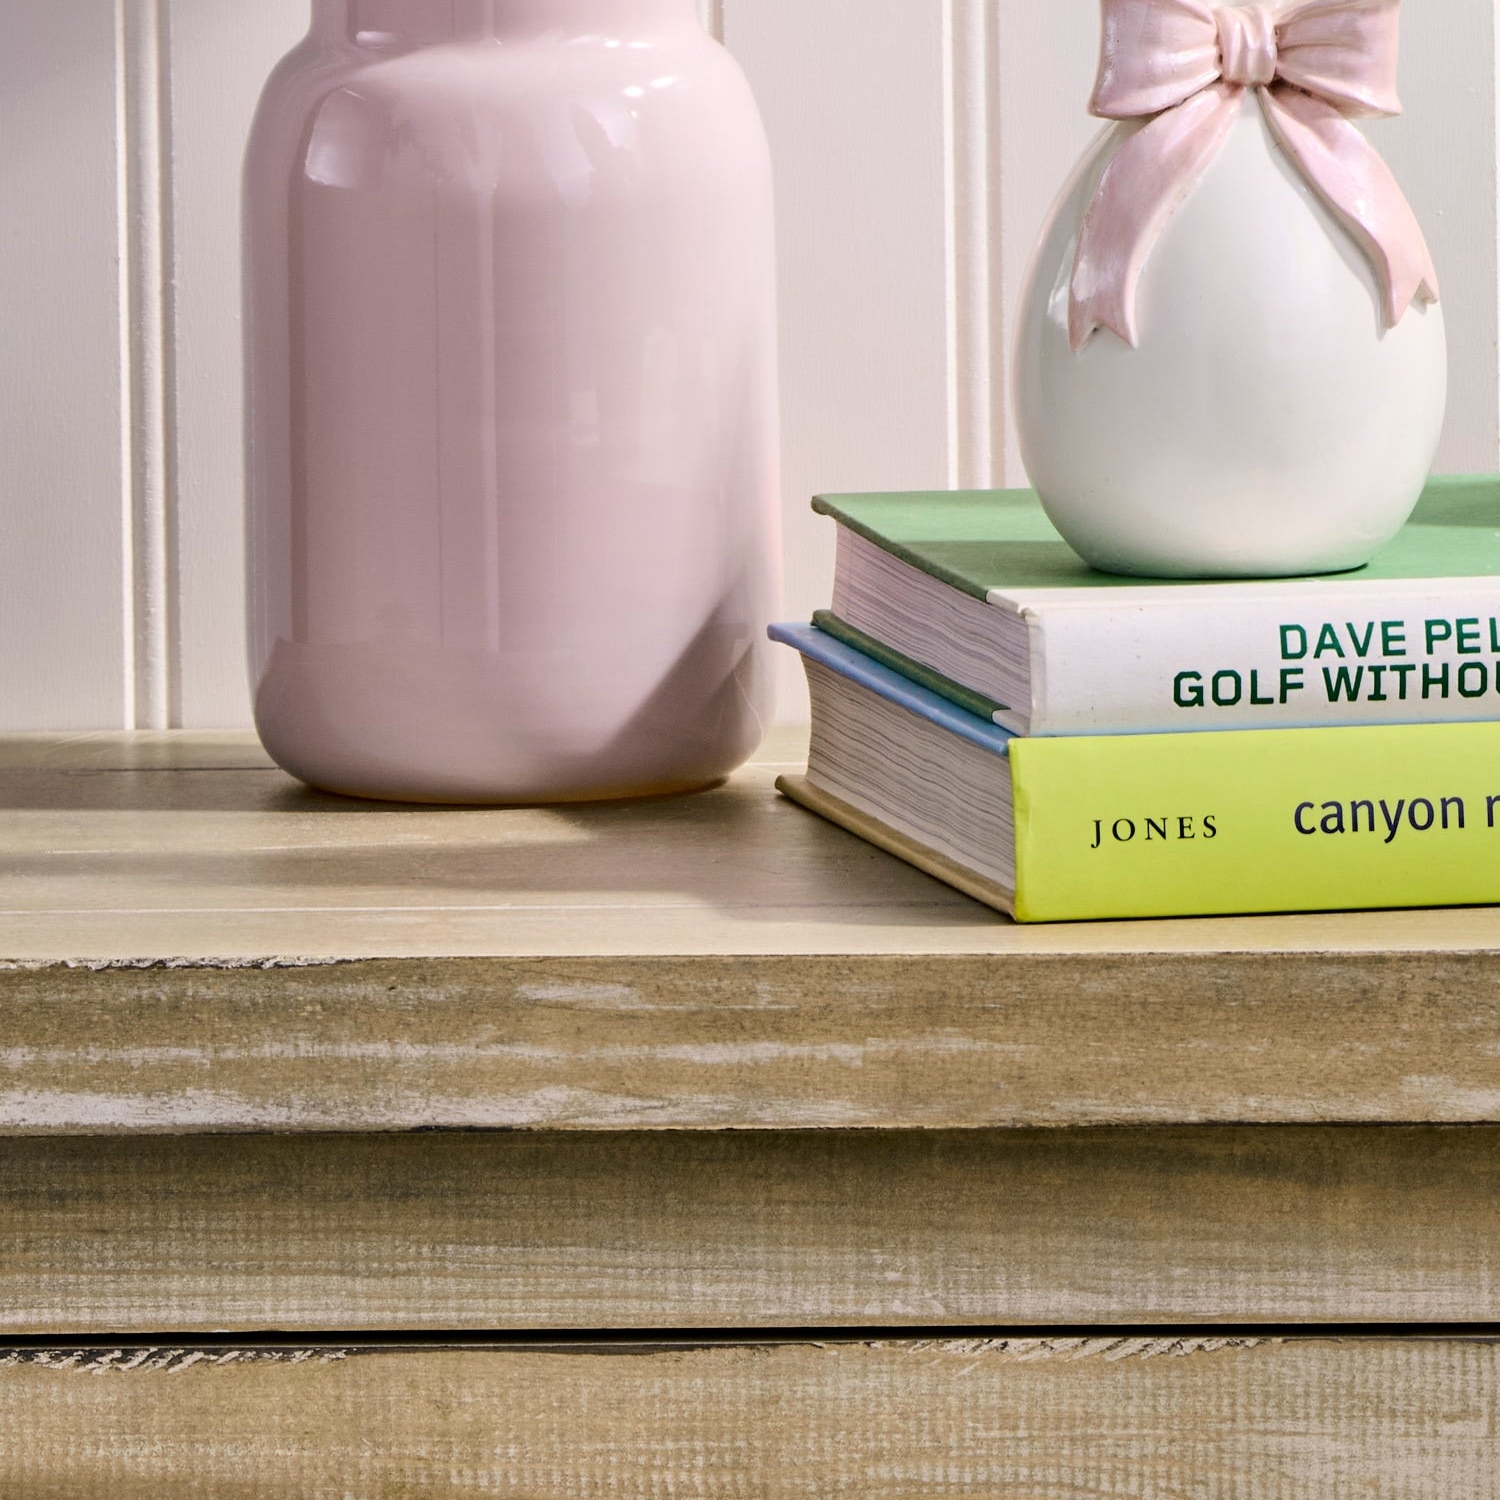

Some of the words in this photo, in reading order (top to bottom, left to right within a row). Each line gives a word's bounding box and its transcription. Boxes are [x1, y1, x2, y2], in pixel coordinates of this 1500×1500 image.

[1279, 620, 1407, 660] DAVE
[1173, 667, 1304, 708] GOLF
[1090, 815, 1217, 849] JONES
[1294, 796, 1465, 844] canyon
